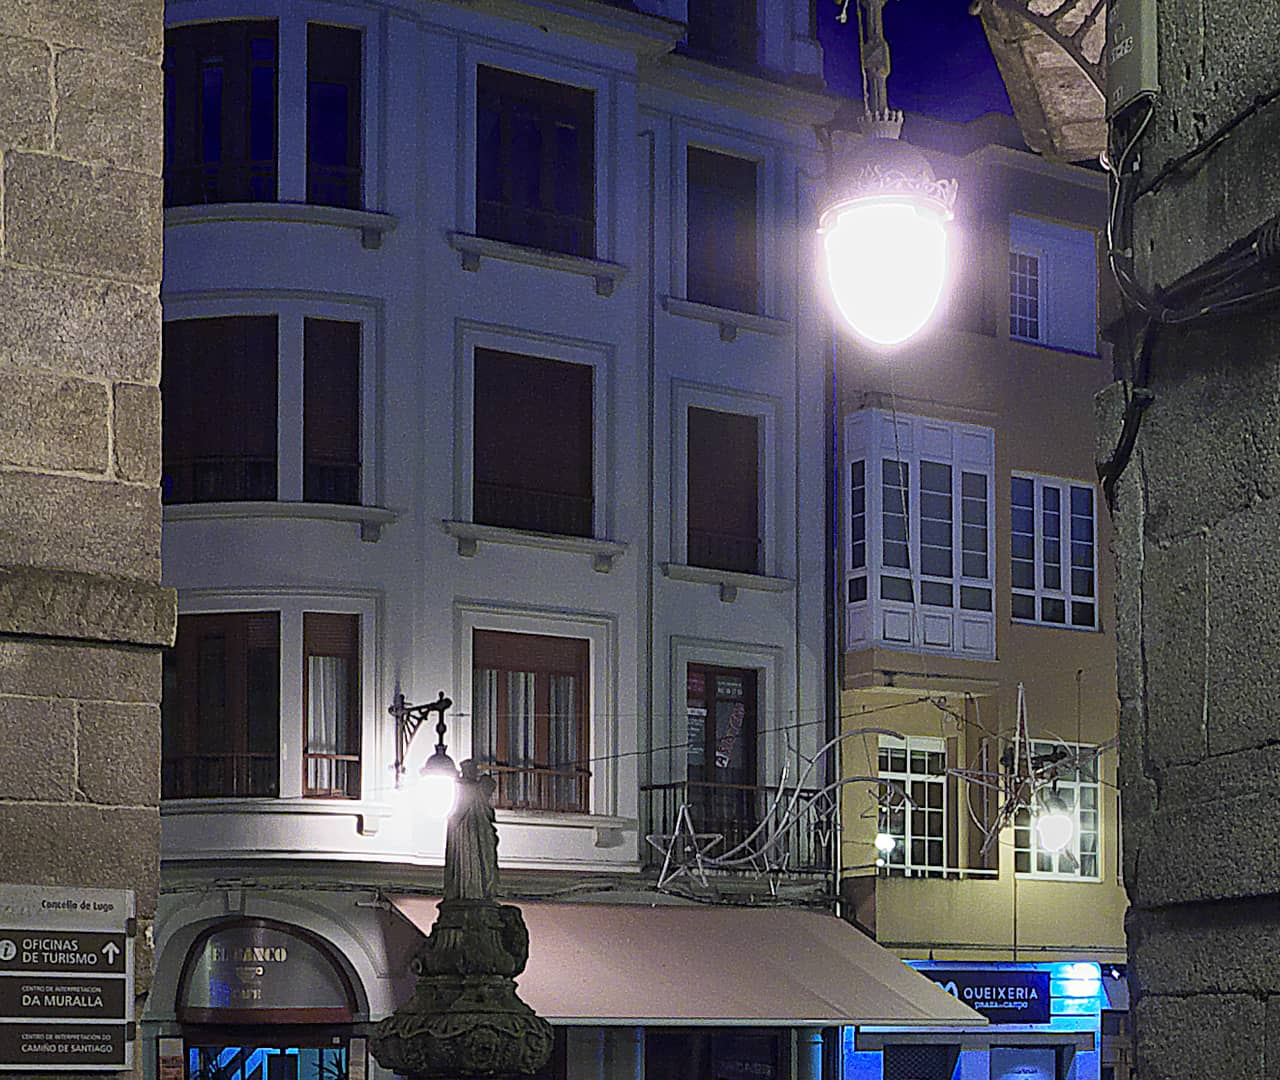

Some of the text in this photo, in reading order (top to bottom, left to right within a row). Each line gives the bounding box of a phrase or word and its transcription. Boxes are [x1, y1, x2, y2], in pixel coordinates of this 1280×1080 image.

[41, 900, 114, 913] Concello de Lugo
[22, 939, 79, 951] OFICINAS
[22, 952, 98, 965] DE TURISMO
[963, 987, 1039, 1000] QUEIXERIA
[22, 994, 104, 1007] DA MURALLA
[21, 1043, 113, 1053] CAMIÑO DE SANTIAGO
